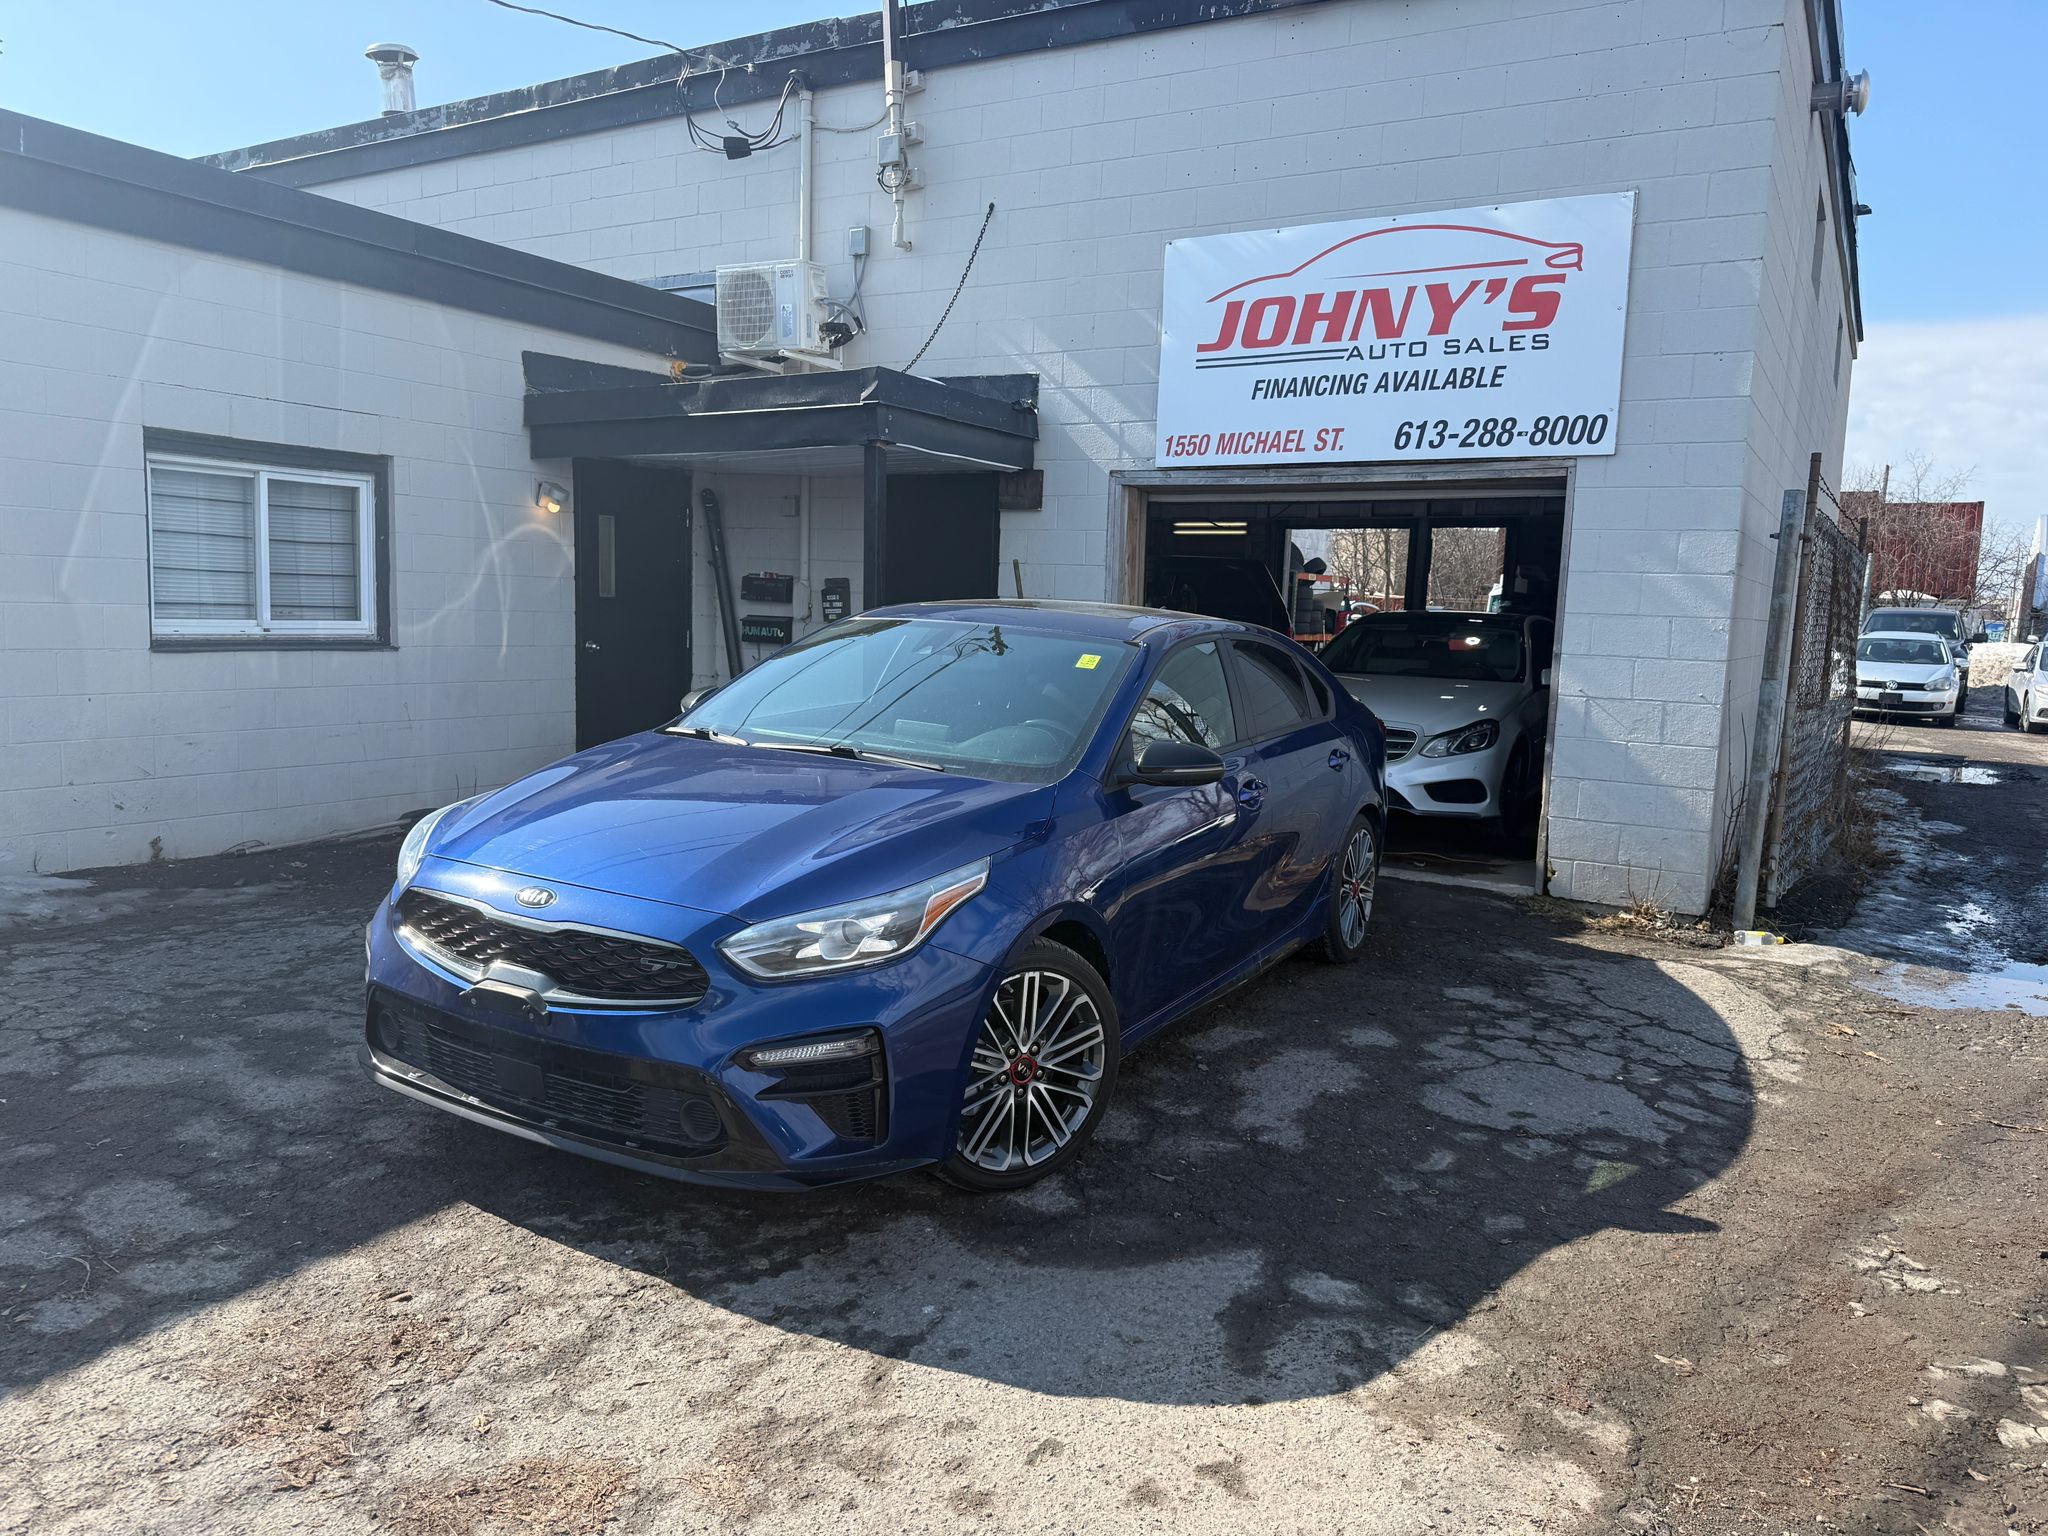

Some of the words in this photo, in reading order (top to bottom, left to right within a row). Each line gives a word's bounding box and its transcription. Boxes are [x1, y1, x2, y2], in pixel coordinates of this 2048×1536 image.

[1196, 273, 1567, 353] JOHNY'S
[1346, 341, 1428, 361] AUTO
[1443, 333, 1550, 355] SALES
[1251, 372, 1369, 400] FINANCING
[1373, 365, 1507, 394] AVAILABLE
[1165, 433, 1211, 457] 1550
[1215, 429, 1306, 455] MICHAEL
[1313, 427, 1345, 451] ST.
[1394, 413, 1609, 450] 613-288-8000
[519, 889, 549, 904] KIA
